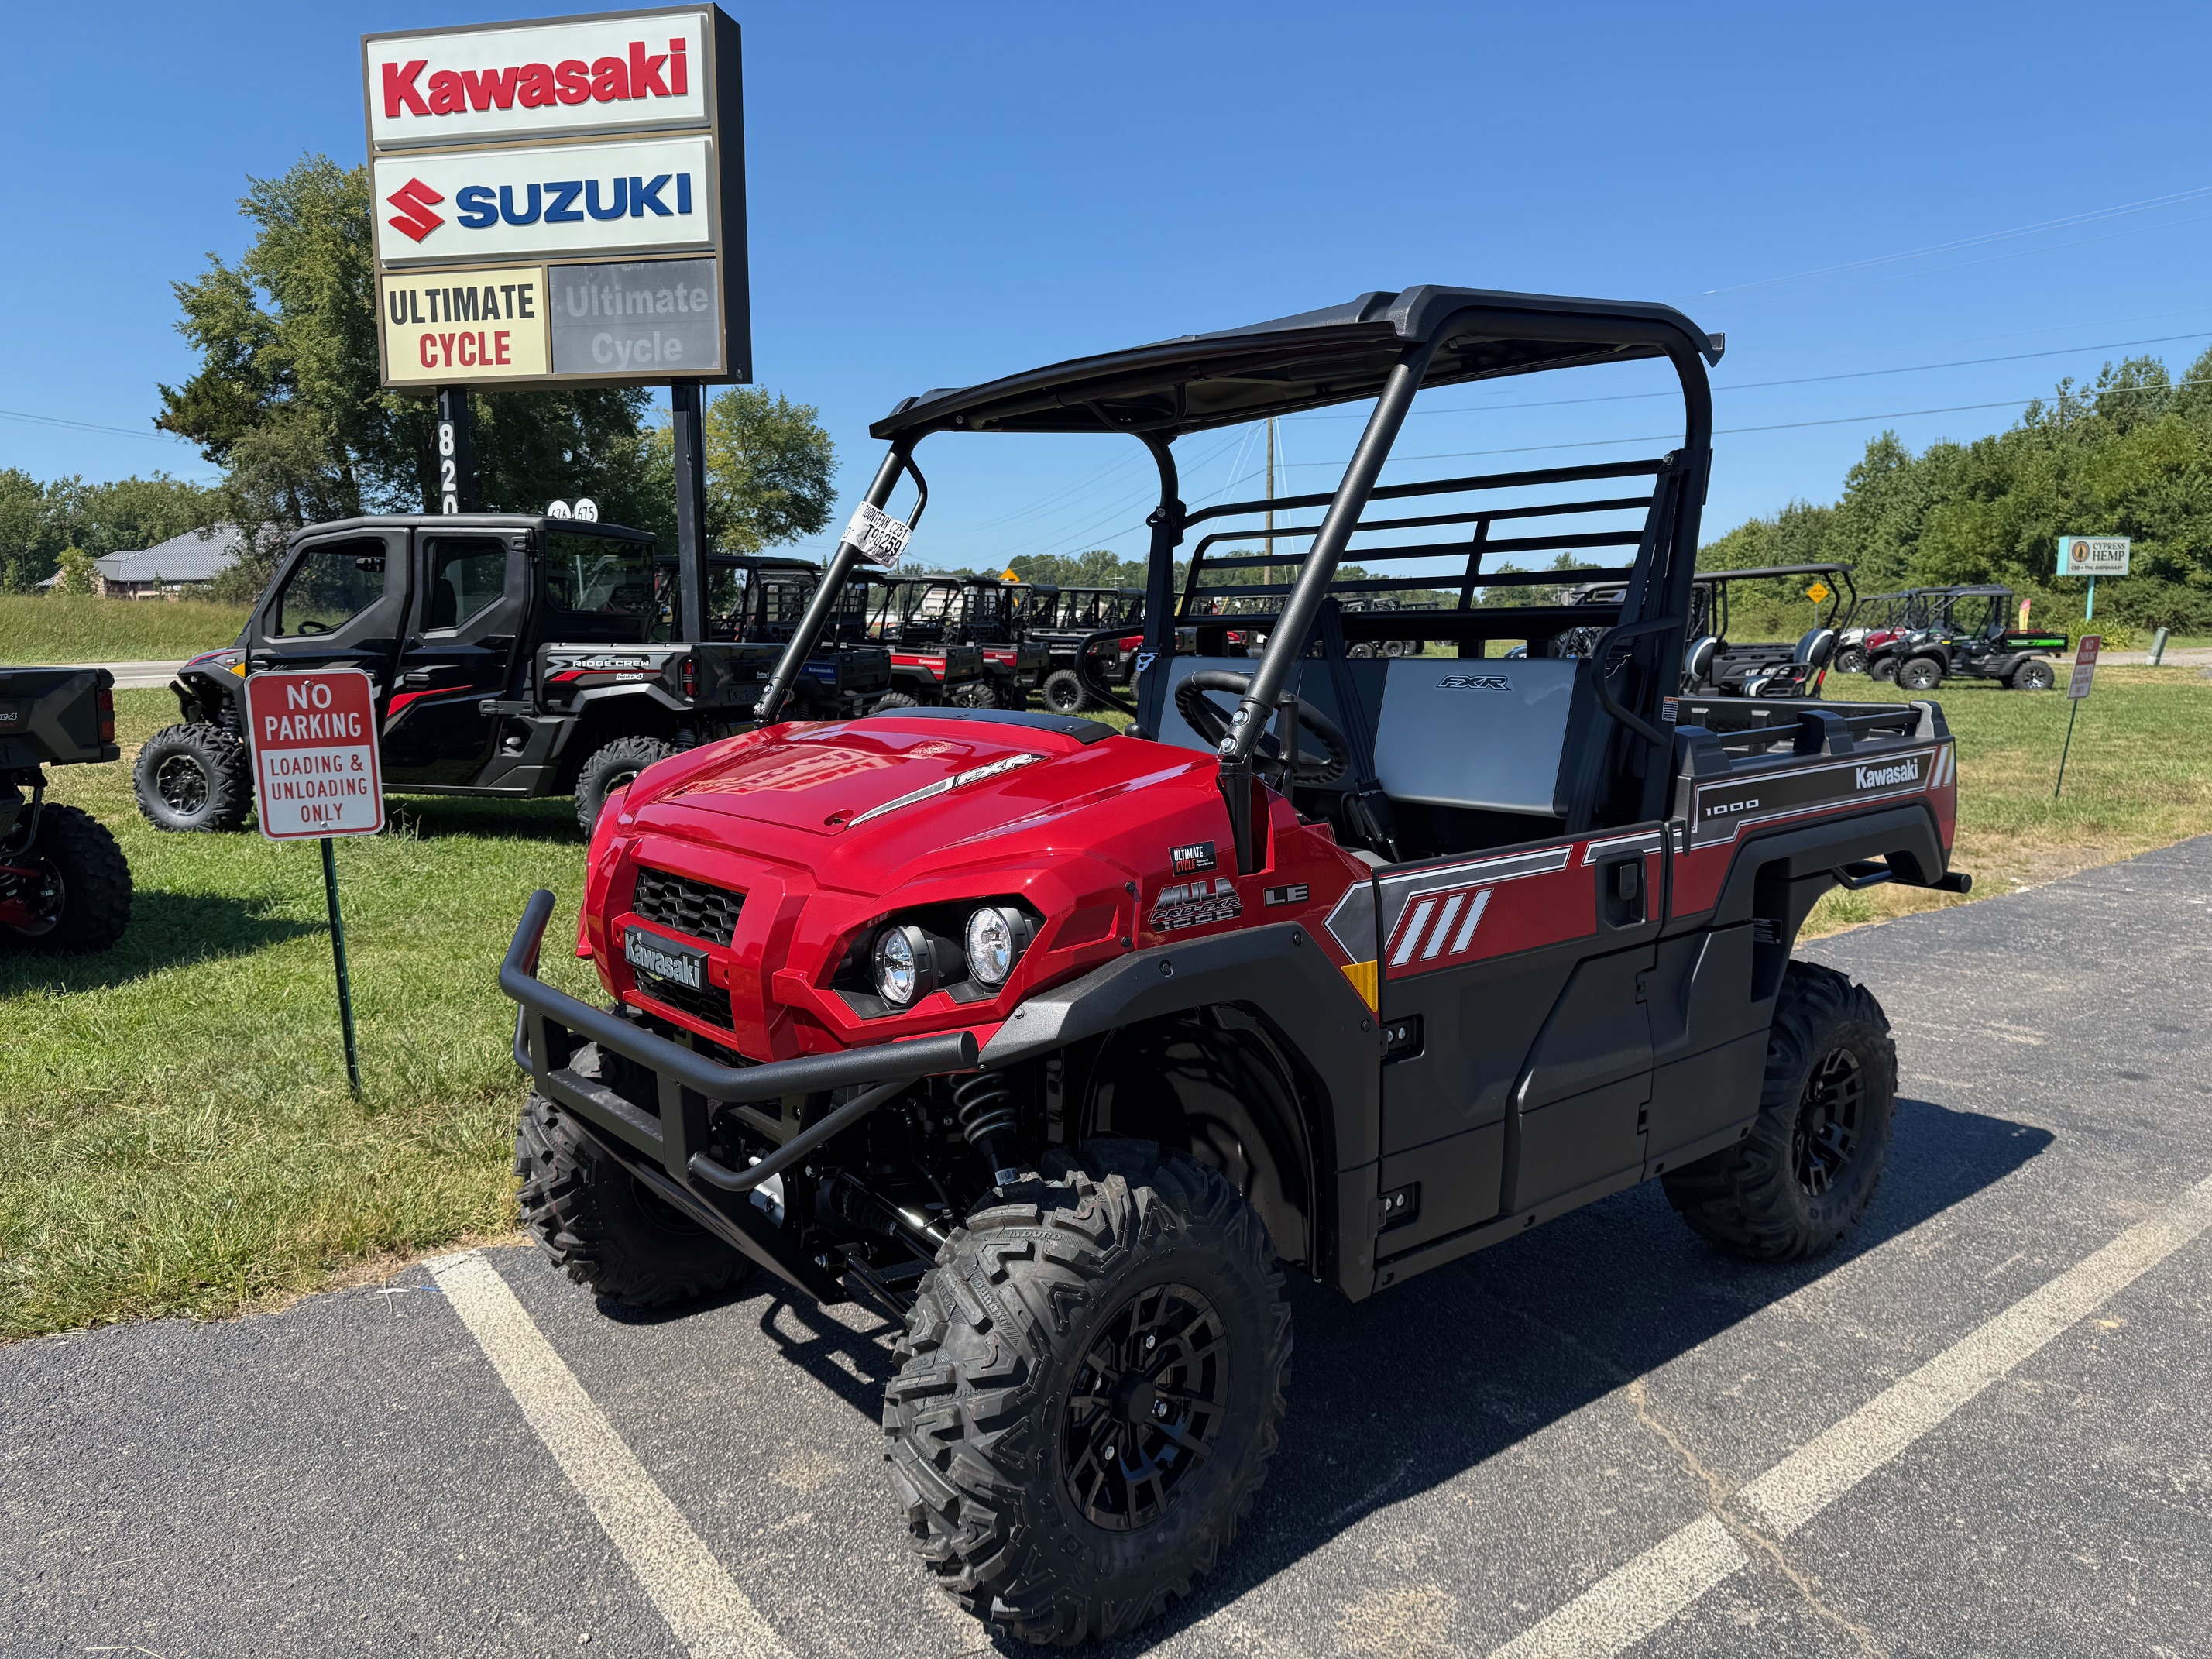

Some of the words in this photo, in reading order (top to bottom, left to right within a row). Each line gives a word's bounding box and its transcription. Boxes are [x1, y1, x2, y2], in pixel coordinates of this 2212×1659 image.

[382, 37, 688, 118] Kawasaki
[455, 172, 692, 228] SUZUKI
[389, 283, 534, 325] ULTIMATE
[565, 280, 709, 317] Ultimate
[419, 330, 511, 368] CYCLE
[591, 330, 683, 366] Cycle
[864, 524, 902, 556] T98259
[2092, 550, 2125, 561] HEMP
[287, 683, 331, 710] NO
[1436, 674, 1513, 691] FXR
[265, 712, 362, 741] PARKING
[270, 755, 342, 776] LOADING
[350, 754, 363, 771] &
[956, 753, 1042, 786] FXR
[1856, 757, 1919, 790] Kawasaki
[271, 778, 368, 800] UNLOADING
[301, 802, 343, 823] ONLY
[1705, 799, 1759, 816] 1000
[1173, 846, 1204, 861] ULTIMATE
[1176, 858, 1196, 872] CYCLE
[1154, 877, 1238, 912] MULE
[1266, 885, 1309, 905] LE
[1150, 896, 1242, 922] PRO-FXR
[1162, 909, 1235, 929] 1000
[624, 932, 700, 988] Kawasaki
